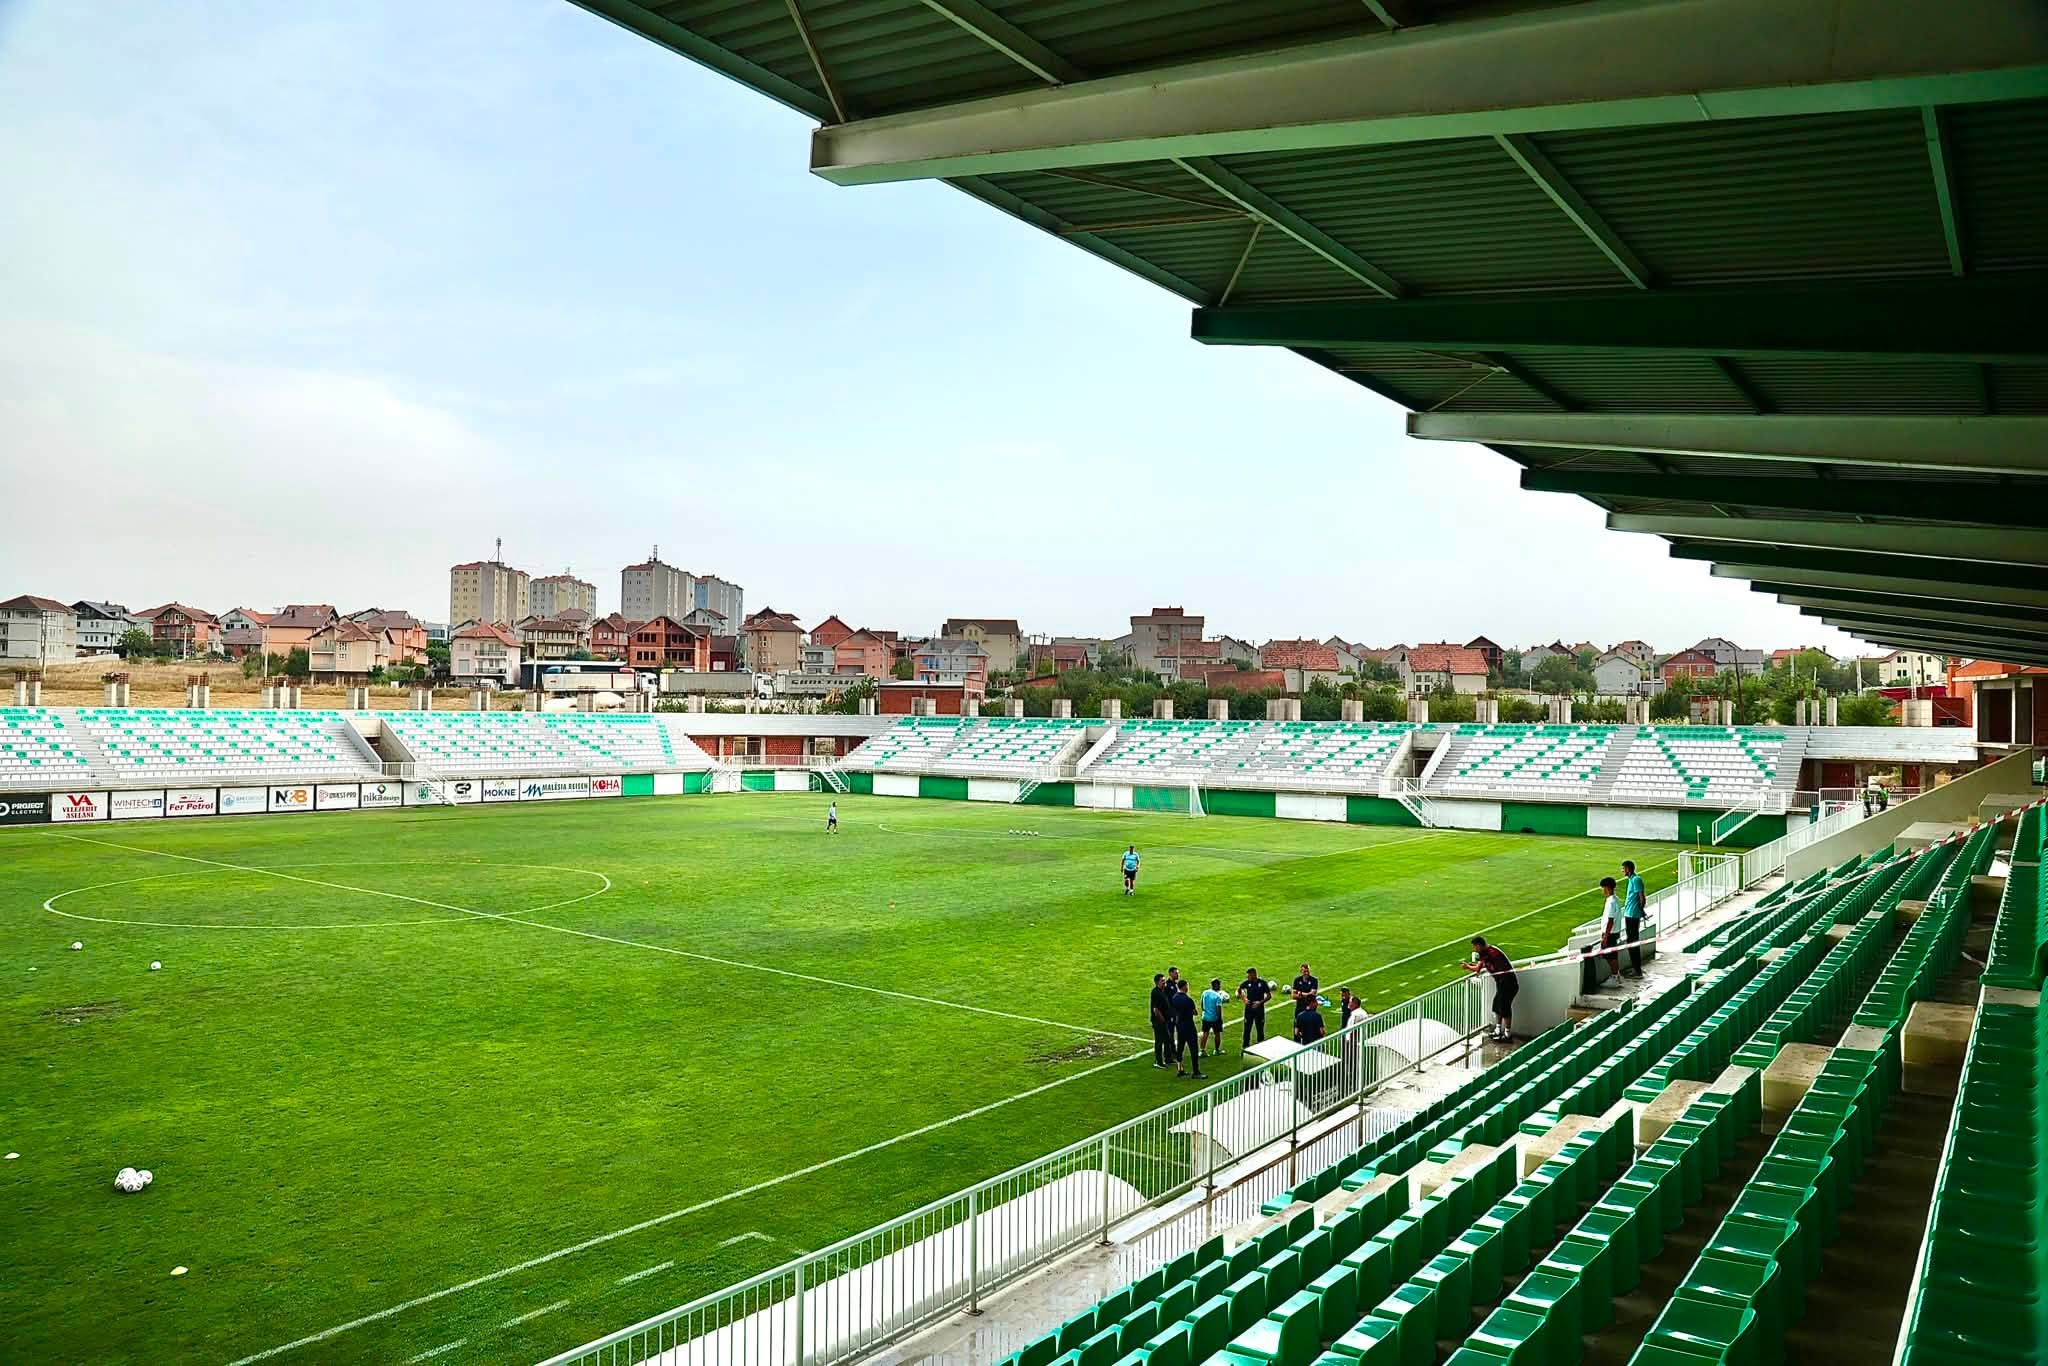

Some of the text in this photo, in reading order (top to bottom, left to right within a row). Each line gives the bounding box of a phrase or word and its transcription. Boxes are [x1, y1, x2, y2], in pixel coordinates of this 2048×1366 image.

[592, 779, 620, 790] KOHA
[363, 792, 383, 802] nika
[484, 789, 516, 797] MOKNE
[67, 795, 93, 806] VA
[169, 802, 214, 811] Fer Petrol
